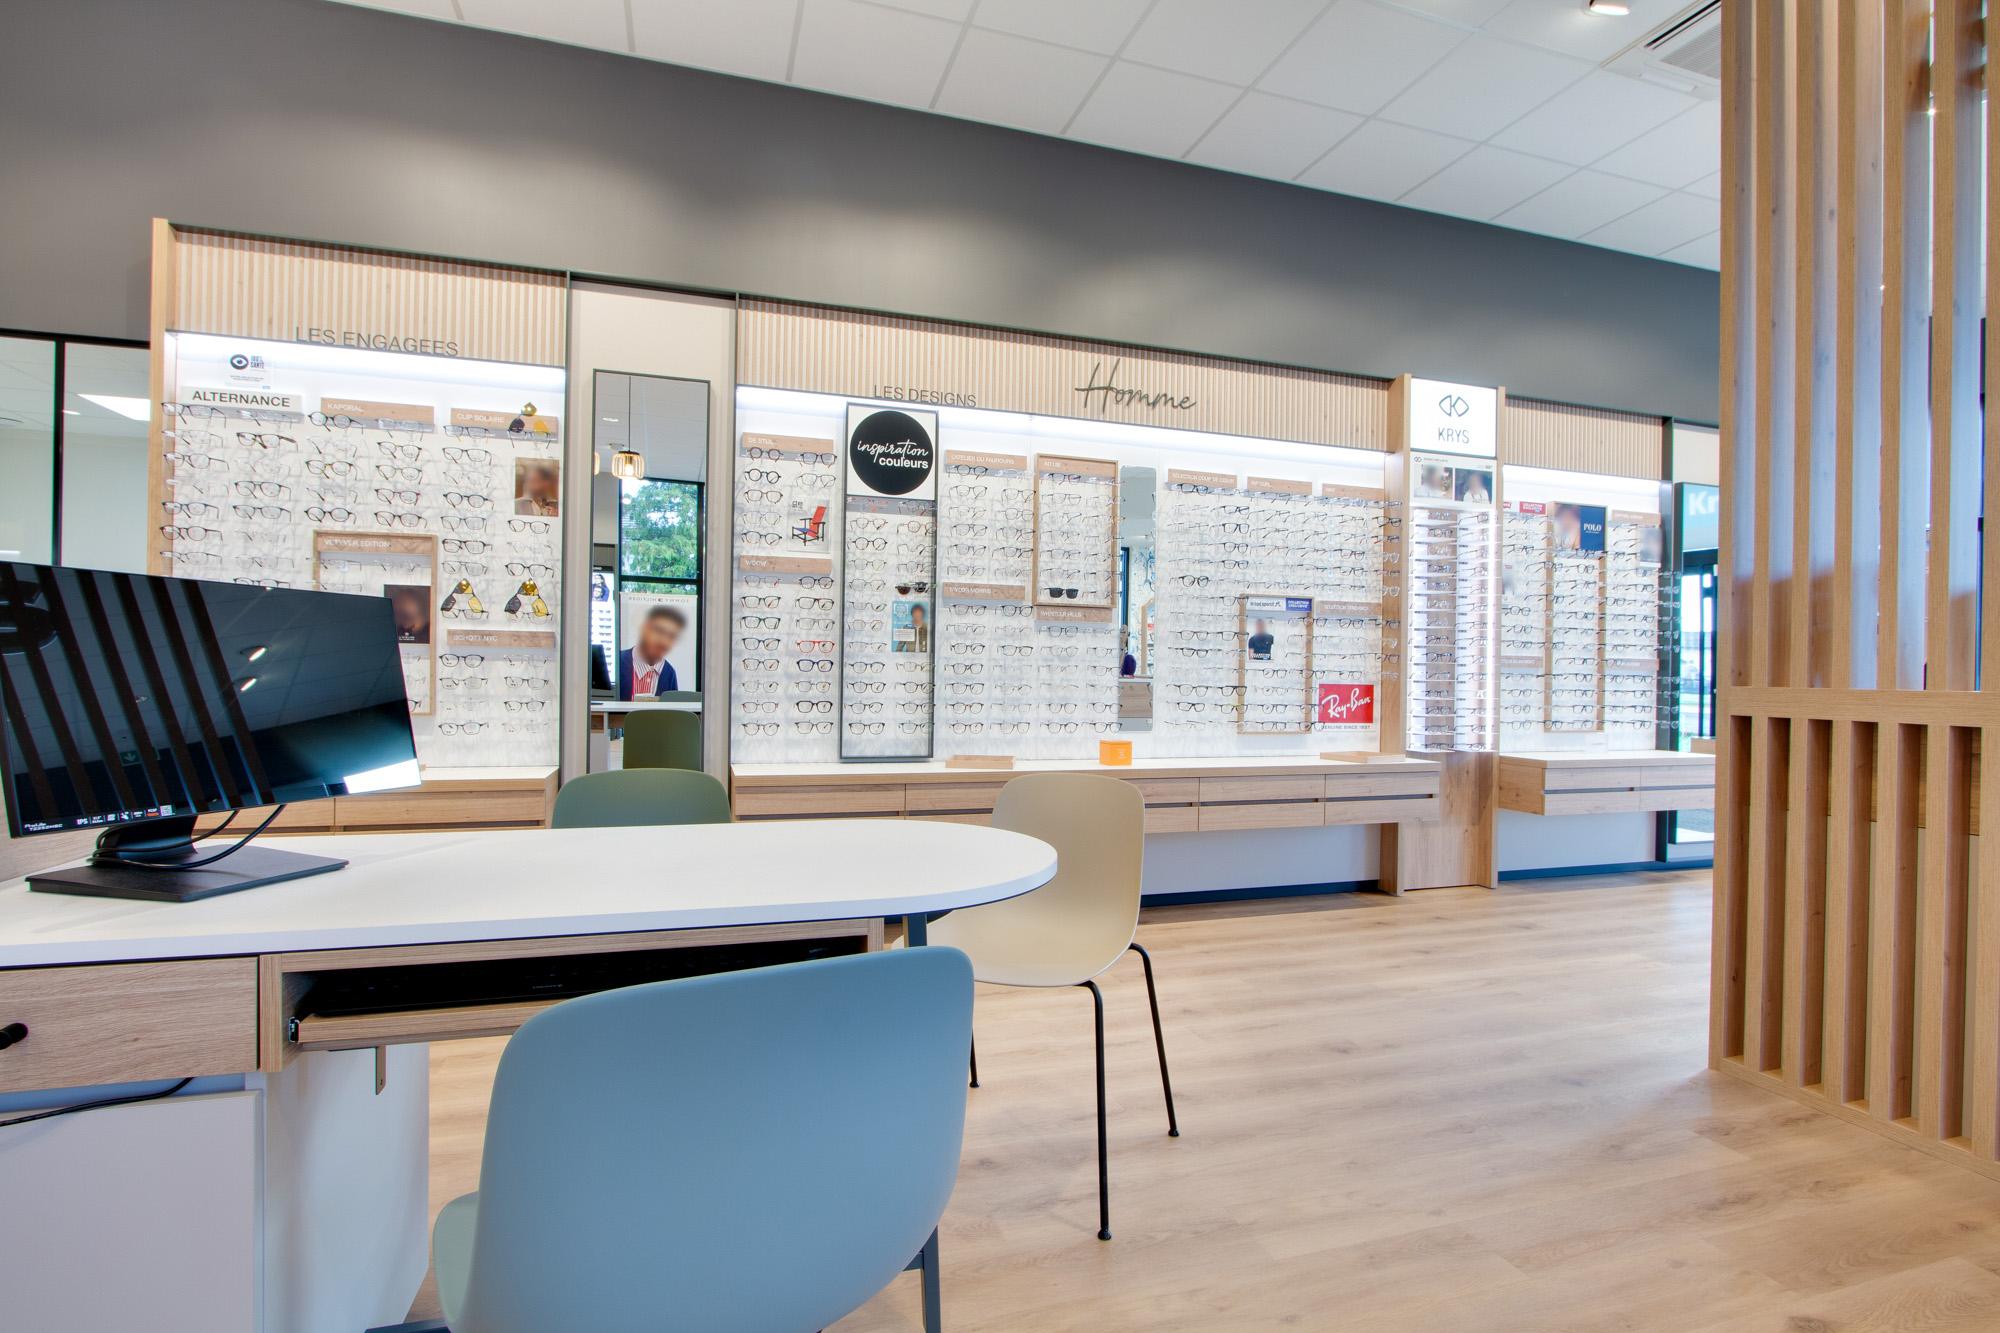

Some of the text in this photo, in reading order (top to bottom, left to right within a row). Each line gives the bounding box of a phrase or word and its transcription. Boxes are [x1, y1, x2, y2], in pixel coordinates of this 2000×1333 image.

[296, 327, 459, 356] LES ENGAGEES
[874, 384, 977, 408] LES DESIGNS
[1075, 358, 1197, 415] Homme
[192, 391, 291, 407] ALTERNANCE
[1438, 427, 1470, 444] KRYS
[857, 438, 929, 463] inspiration
[879, 457, 929, 469] couleurs
[1583, 522, 1602, 532] POLO
[1321, 687, 1371, 718] Ray-Ban
